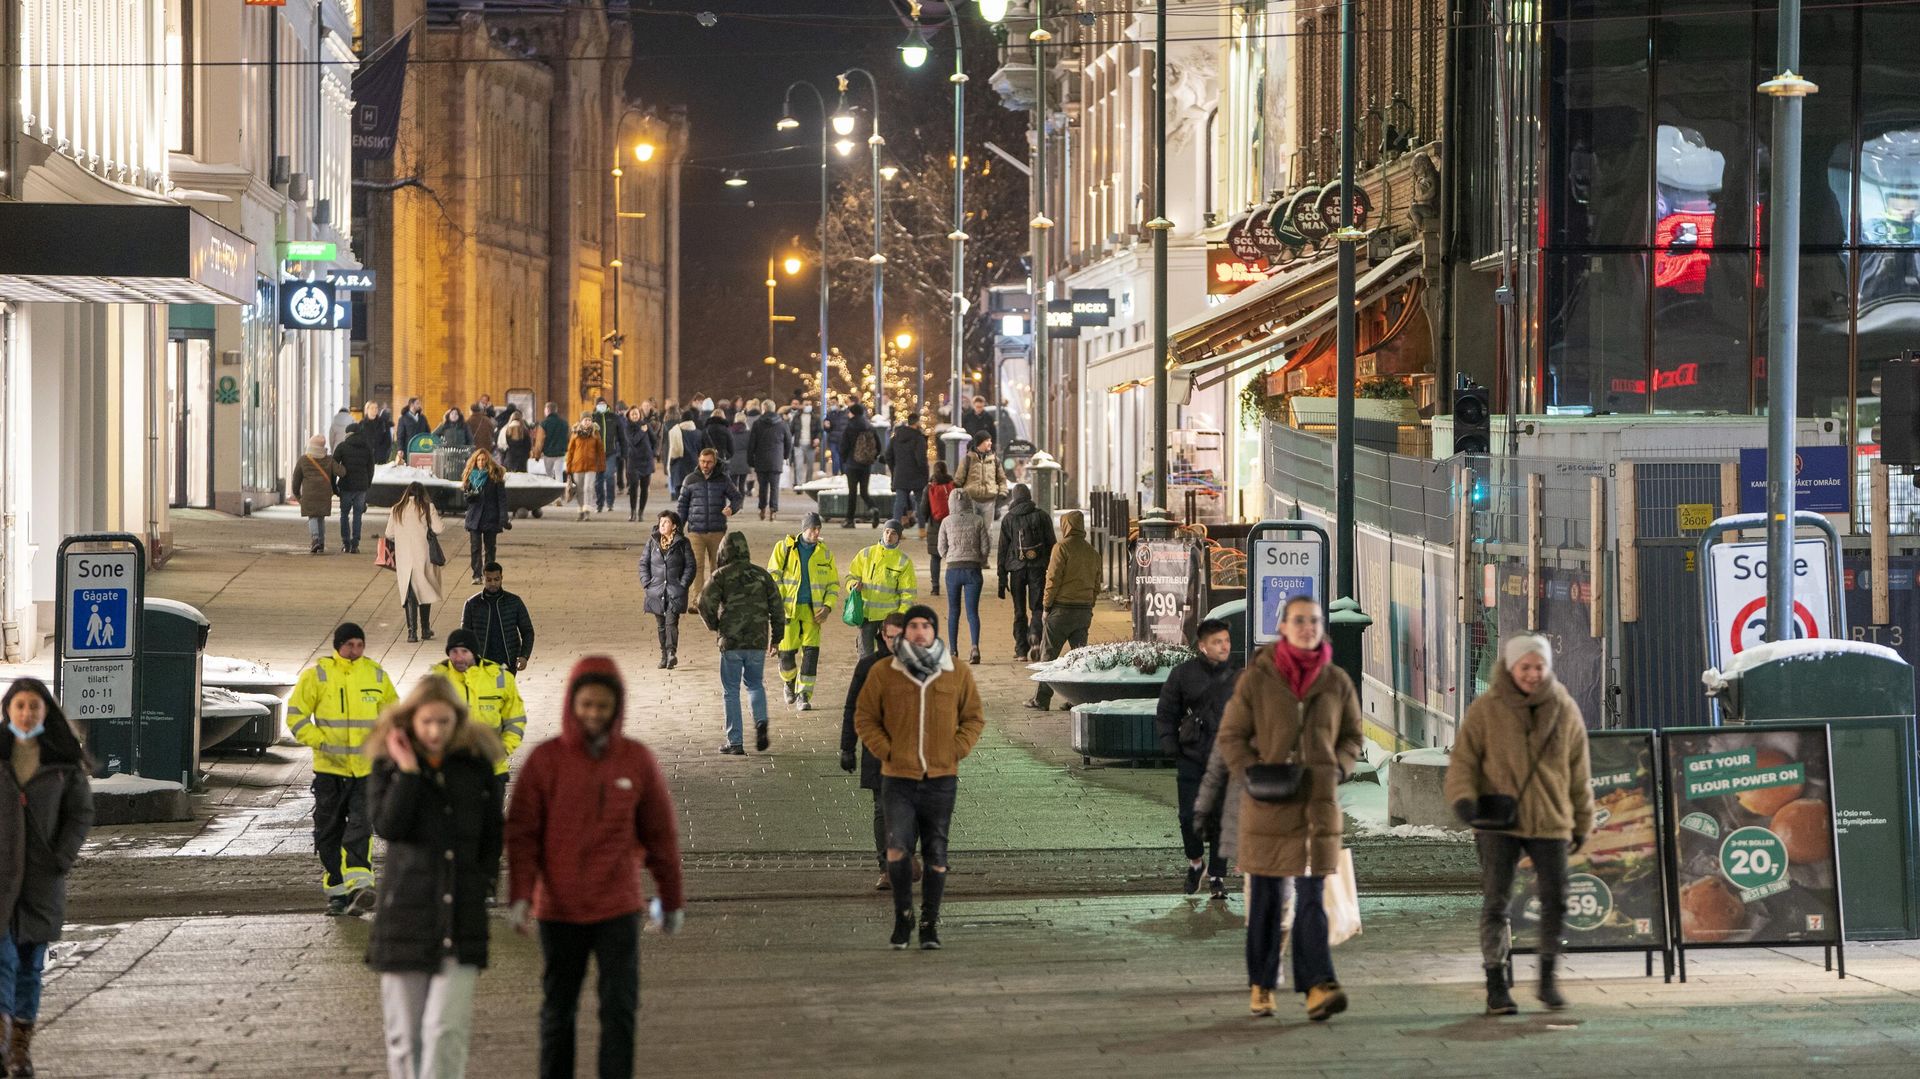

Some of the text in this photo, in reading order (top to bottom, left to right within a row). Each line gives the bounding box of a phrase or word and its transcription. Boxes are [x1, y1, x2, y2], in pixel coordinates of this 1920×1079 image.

[1813, 477, 1841, 487] OMRÅDE
[1682, 516, 1708, 526] 2606
[1266, 547, 1310, 566] Sone
[78, 560, 124, 578] Sone
[1733, 554, 1808, 580] Soe
[1271, 577, 1305, 590] Gågate
[82, 591, 119, 603] Gågate
[1890, 625, 1904, 646] 3
[72, 664, 124, 674] Varetransport
[87, 675, 109, 684] tillatt
[1689, 754, 1751, 772] GET YOUR
[1613, 772, 1633, 784] ME
[1691, 769, 1799, 794] FLOUR POWER ON
